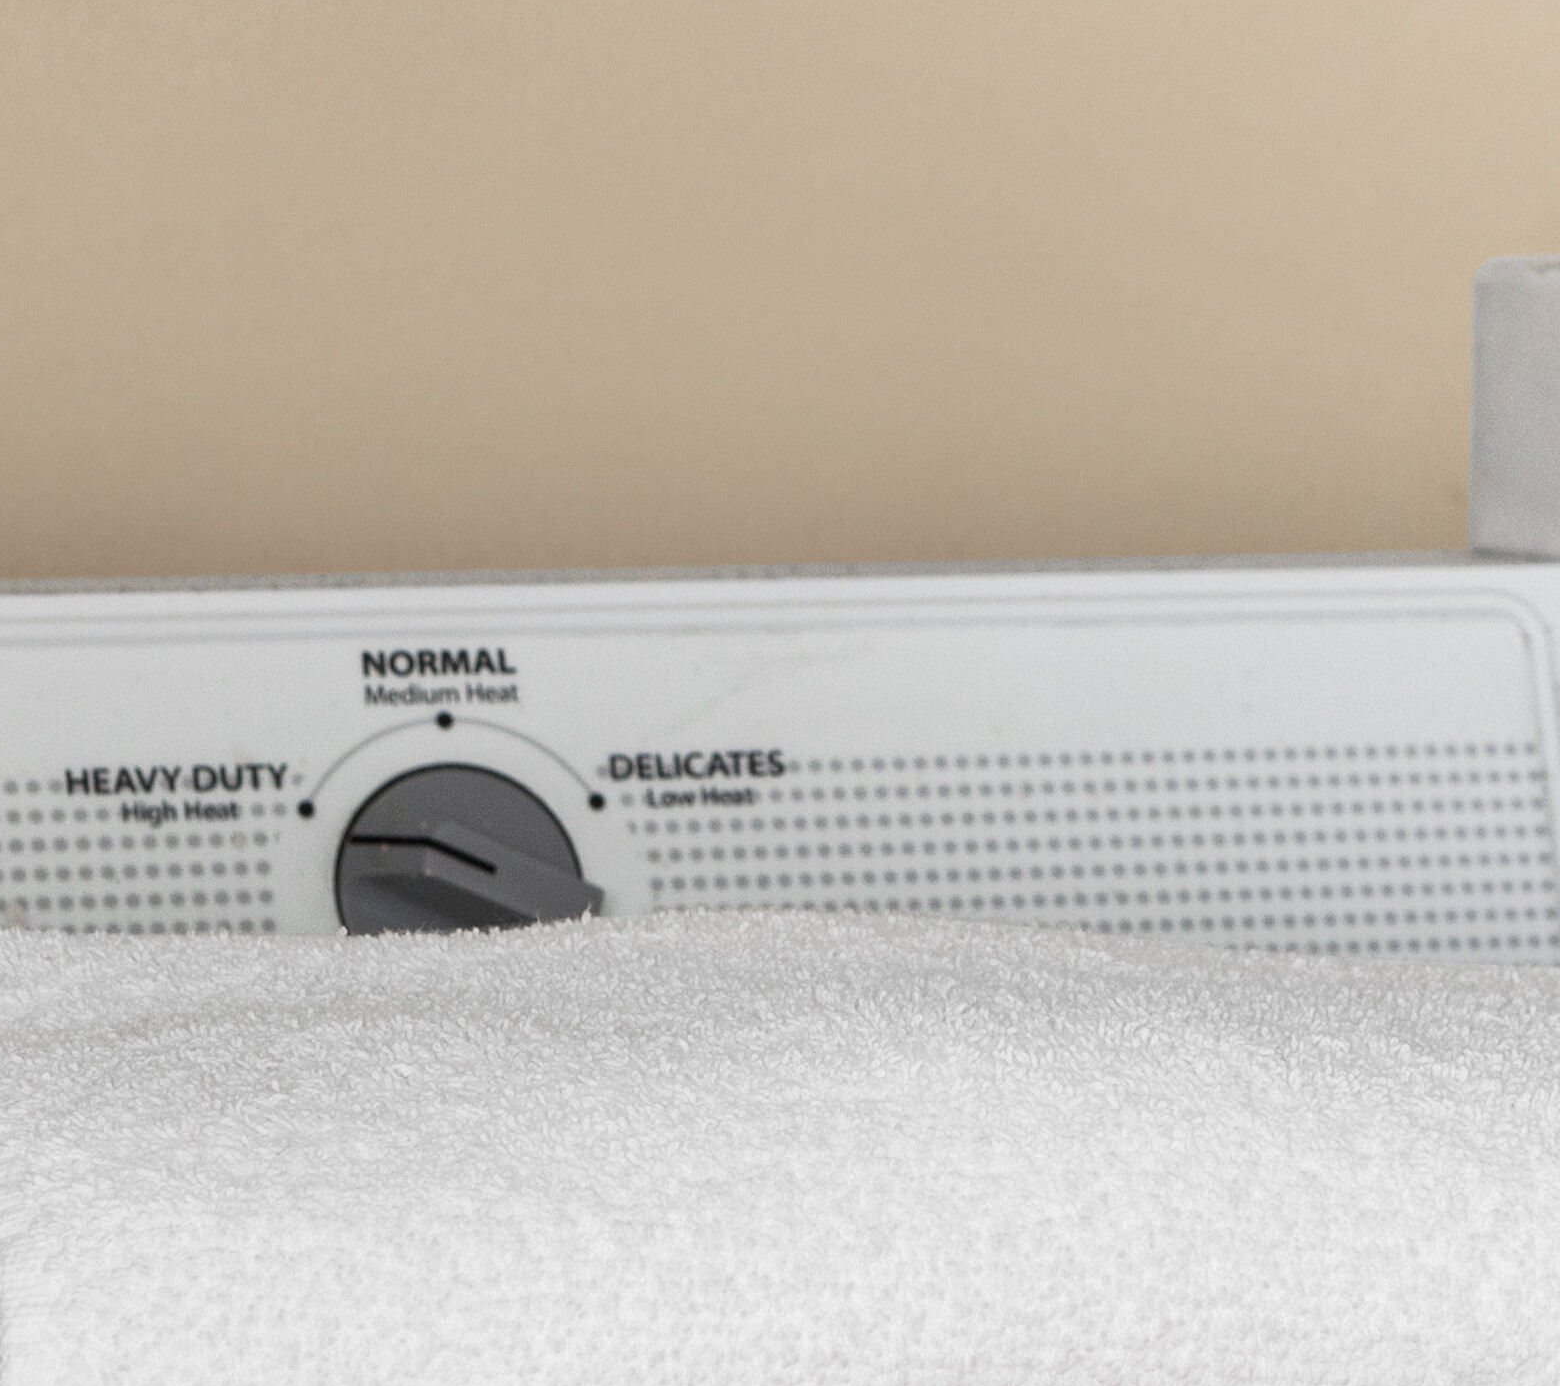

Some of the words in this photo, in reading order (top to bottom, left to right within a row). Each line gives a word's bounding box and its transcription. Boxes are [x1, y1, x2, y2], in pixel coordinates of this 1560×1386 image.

[362, 647, 517, 676] NORMAL
[364, 682, 460, 705] Medium
[465, 681, 518, 703] Heat
[65, 765, 181, 795] HEAVY
[192, 763, 287, 793] DUTY
[609, 748, 785, 781] DELICATES
[646, 787, 695, 808] Low
[701, 786, 754, 807] Heat
[120, 799, 178, 828] High
[184, 800, 238, 821] Heat
